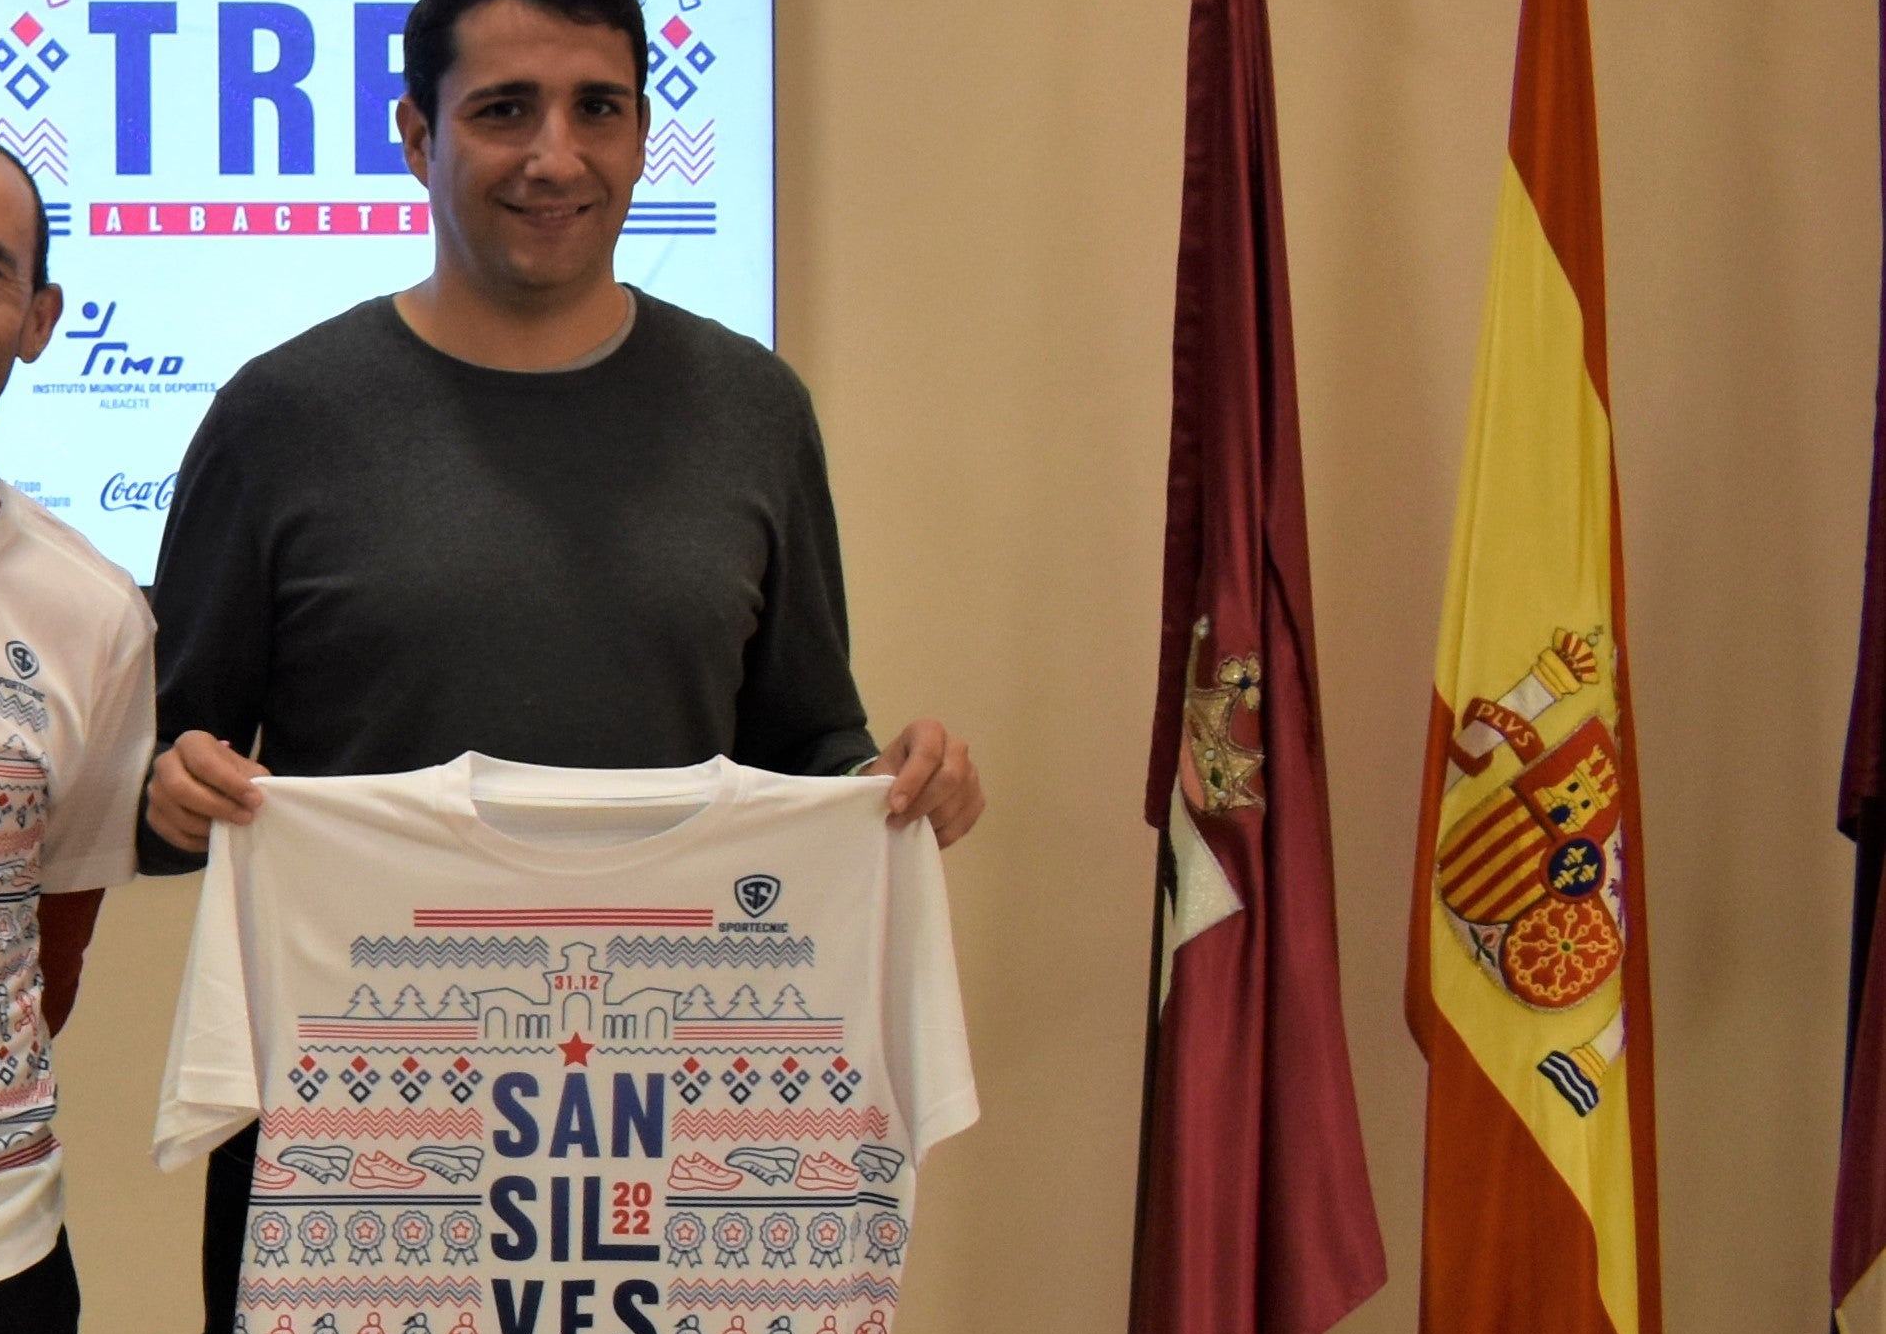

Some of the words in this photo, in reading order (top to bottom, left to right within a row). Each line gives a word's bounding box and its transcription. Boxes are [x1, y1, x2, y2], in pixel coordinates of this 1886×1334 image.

[88, 1, 418, 175] TRE
[106, 203, 412, 232] ALBACETE
[32, 383, 87, 394] INSTITUTO
[89, 383, 146, 393] MUNICIPAL
[149, 383, 161, 393] DE
[99, 398, 150, 409] ALBACETE
[1476, 702, 1535, 747] PLVS
[718, 922, 788, 934] SPORTECNIC
[554, 974, 599, 991] 31.12
[491, 1071, 665, 1160] SAN
[613, 1182, 652, 1209] 20
[490, 1175, 660, 1263] SIL
[613, 1210, 651, 1236] 22
